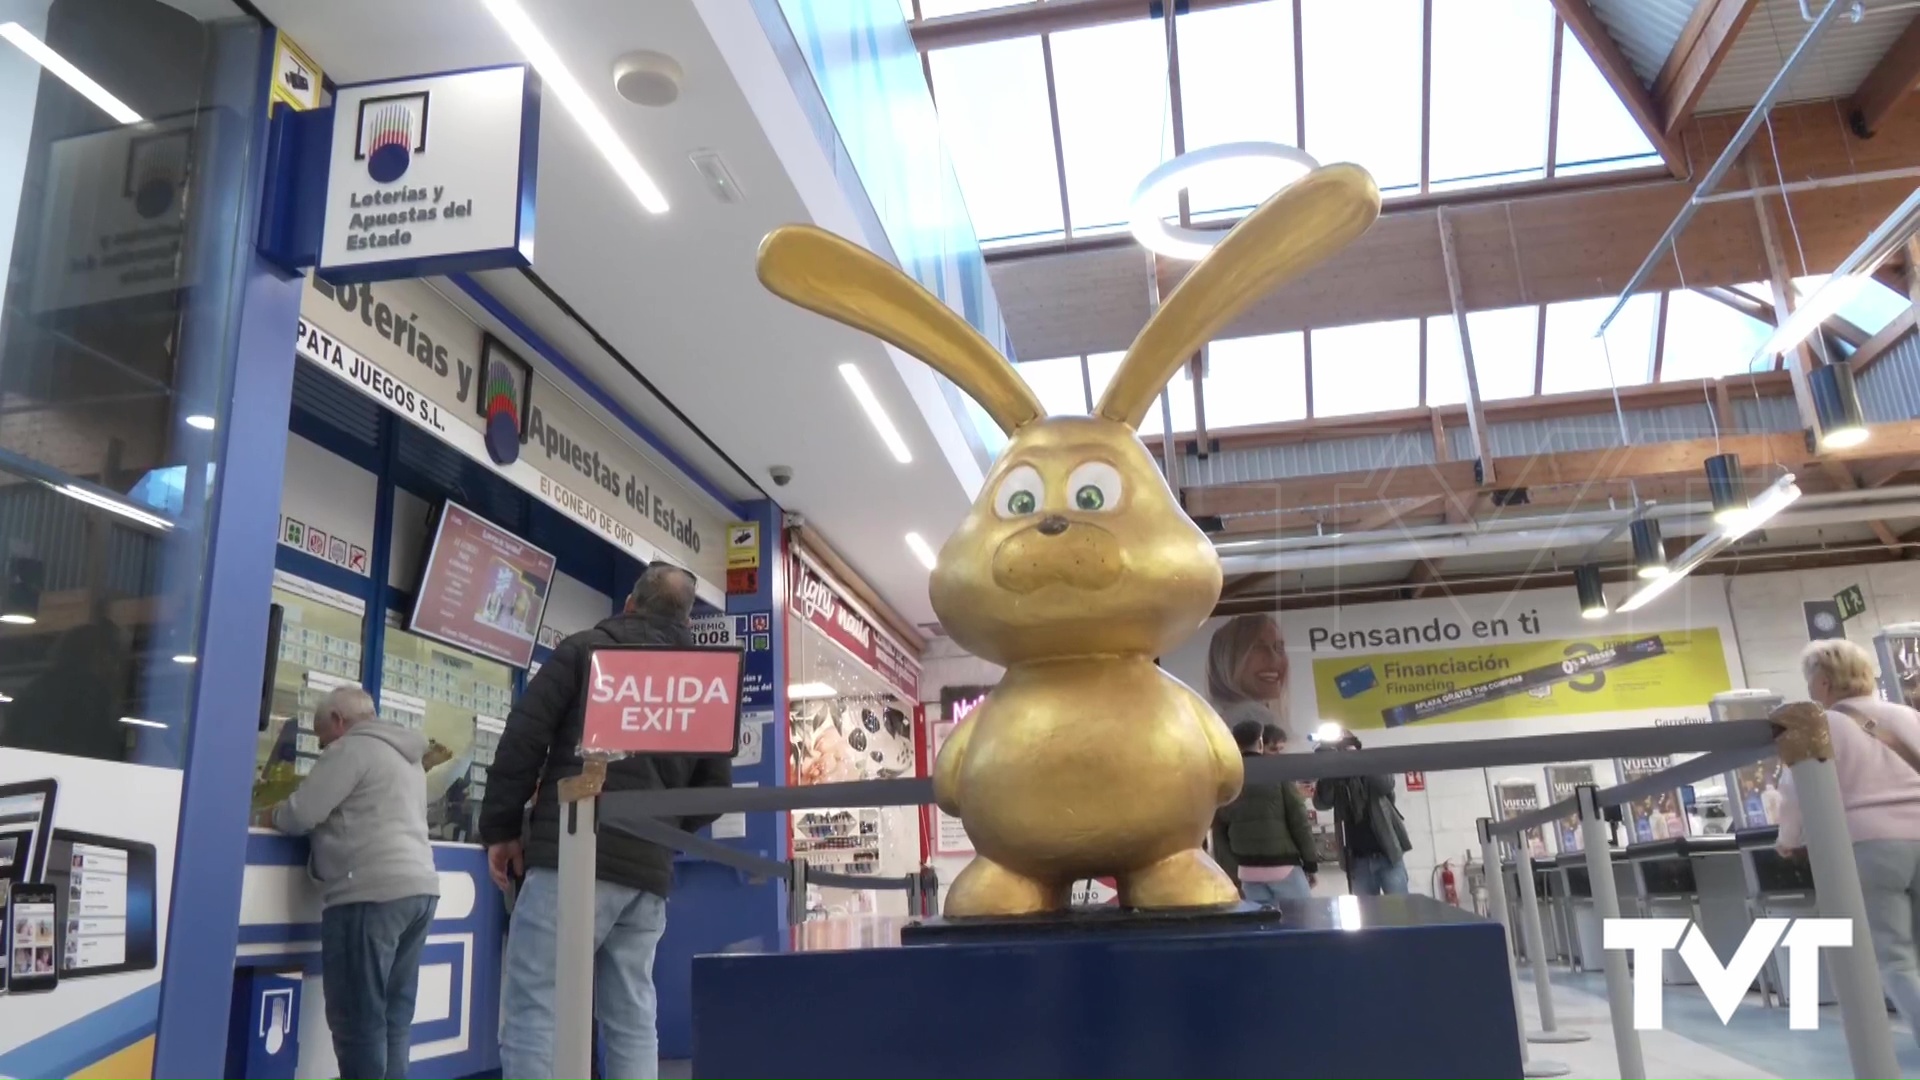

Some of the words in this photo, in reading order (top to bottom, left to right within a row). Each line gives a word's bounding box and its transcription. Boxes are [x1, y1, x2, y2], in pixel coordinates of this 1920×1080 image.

[350, 185, 427, 208] Loterías
[433, 185, 444, 203] y
[349, 207, 437, 232] Apuestas
[443, 198, 472, 219] del
[346, 228, 412, 251] Estado
[456, 357, 473, 403] y
[350, 357, 415, 413] JUEGOS
[419, 398, 446, 432] S.L.
[528, 405, 621, 497] Apuestas
[626, 474, 649, 519] del
[653, 495, 700, 554] Estado
[554, 485, 597, 524] CONEJO
[600, 513, 612, 534] DE
[691, 621, 726, 632] REMIO
[1308, 617, 1461, 651] Pensando
[1471, 617, 1509, 638] en
[1517, 608, 1541, 634] ti
[1383, 652, 1510, 679] Financiación
[591, 675, 729, 705] SALIDA
[1386, 679, 1455, 695] Financing
[1442, 688, 1472, 702] GRATIS
[621, 707, 696, 732] EXIT
[1623, 757, 1669, 769] VUELVE
[1503, 798, 1537, 808] VUELVE
